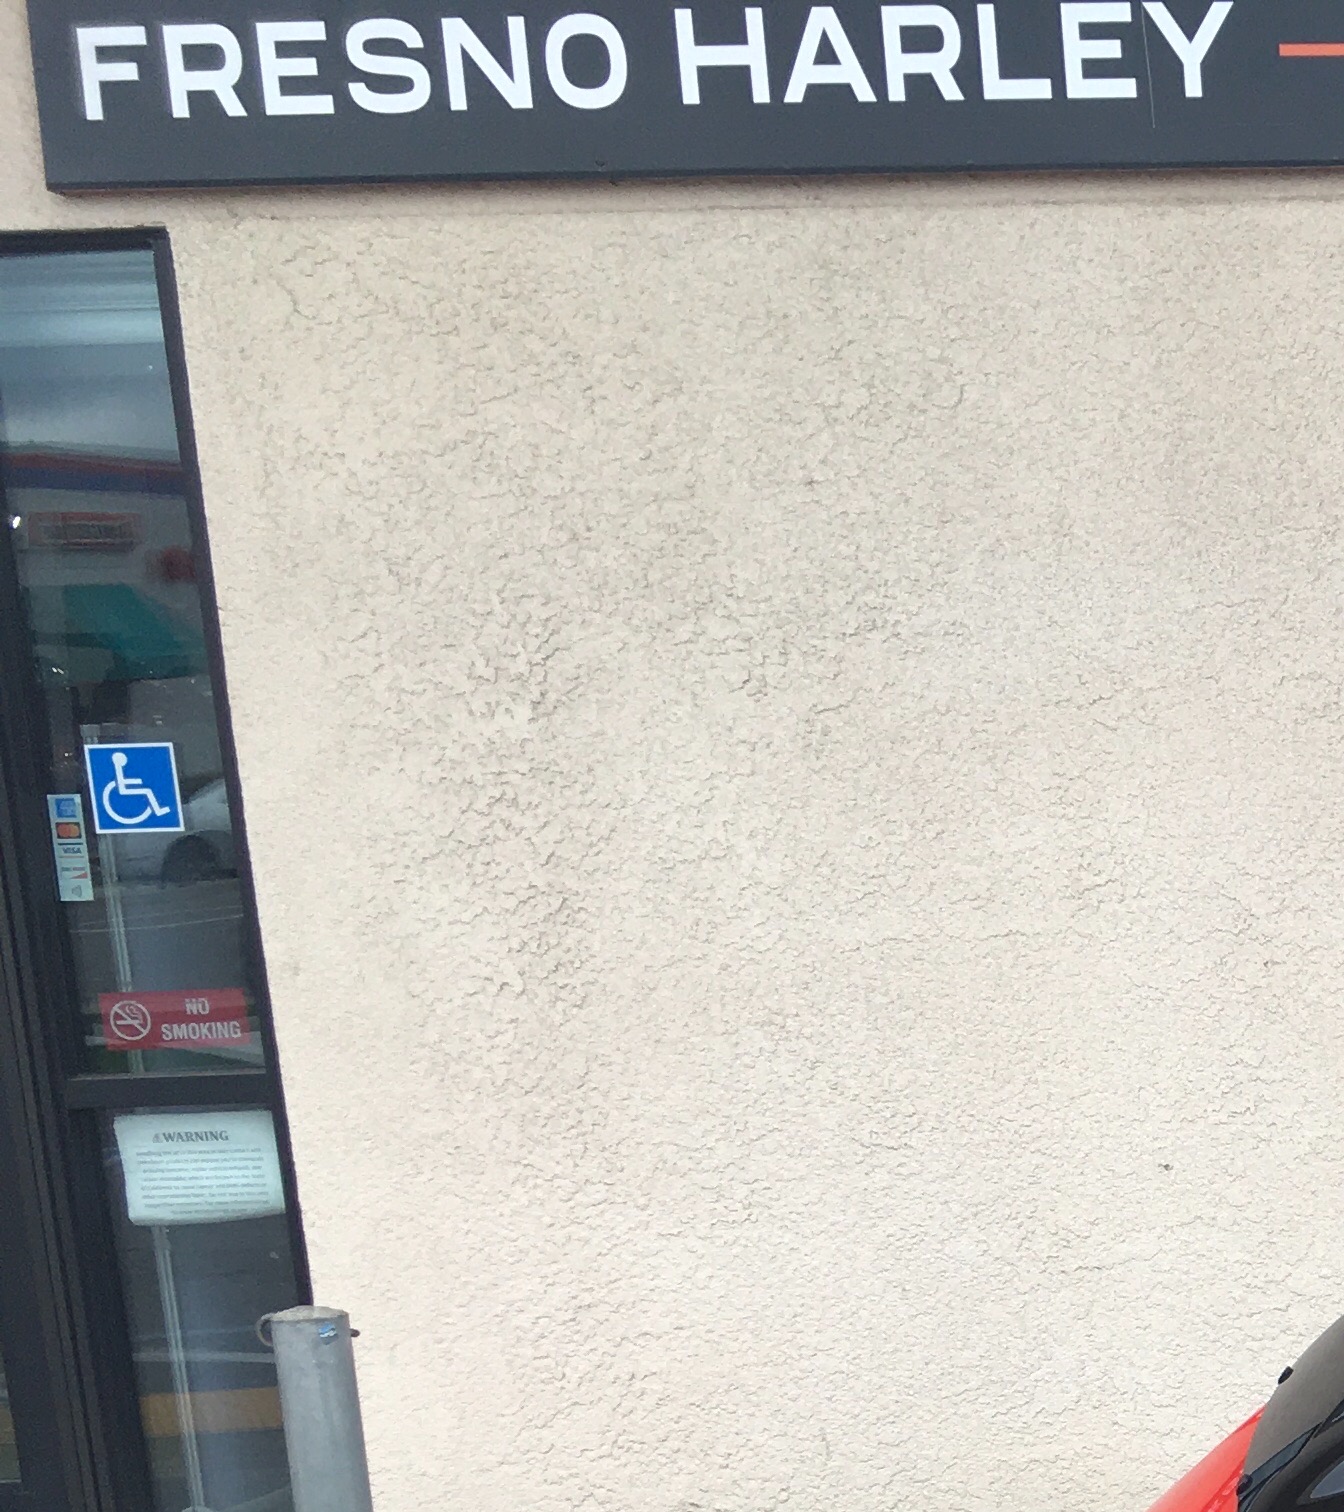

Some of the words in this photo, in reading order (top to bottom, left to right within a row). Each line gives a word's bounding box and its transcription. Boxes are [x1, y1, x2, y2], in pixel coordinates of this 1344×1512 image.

[73, 13, 628, 122] FRESNO
[676, 0, 1234, 105] HARLEY
[184, 997, 210, 1015] NO
[161, 1021, 242, 1040] SMOKING
[163, 1130, 230, 1142] WARNING
